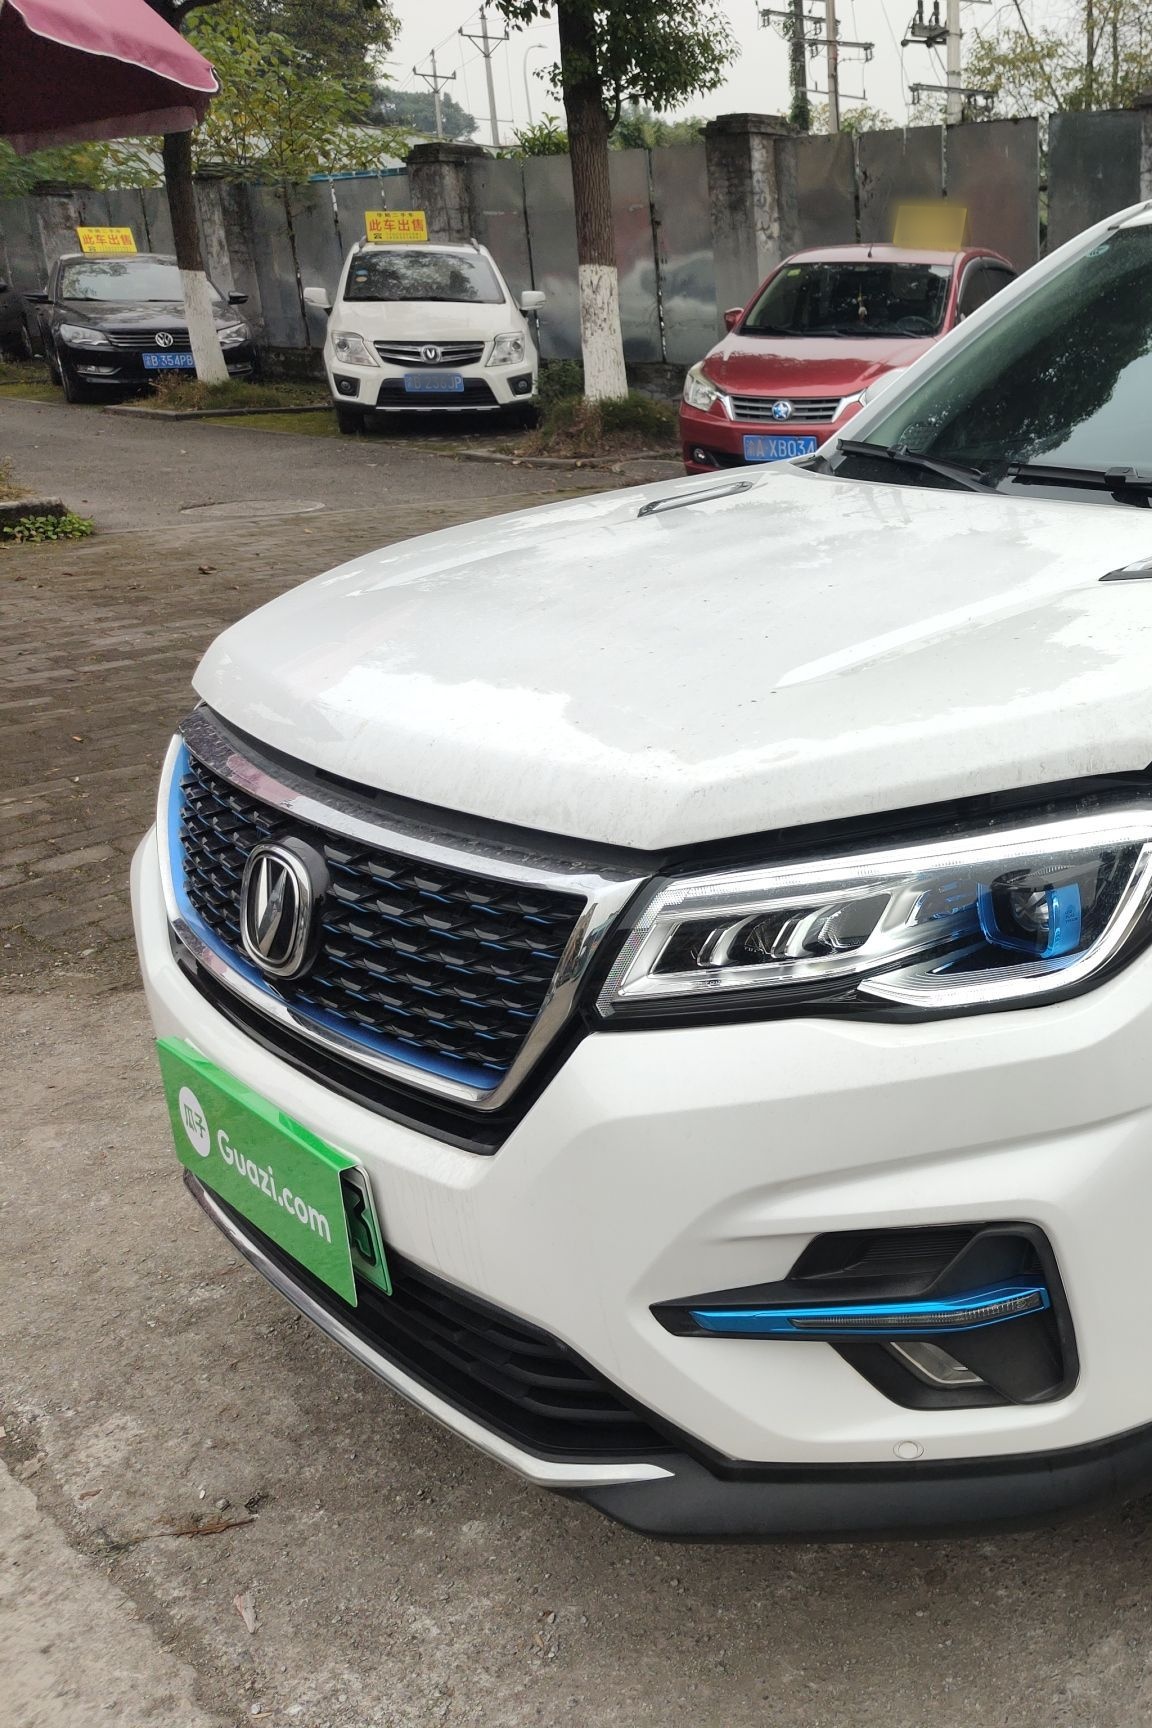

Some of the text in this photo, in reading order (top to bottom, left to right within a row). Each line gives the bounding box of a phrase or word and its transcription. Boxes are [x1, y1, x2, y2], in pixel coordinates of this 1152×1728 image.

[369, 218, 424, 232] 此车出售
[82, 233, 132, 246] 此车出售
[182, 1102, 206, 1139] 瓜子
[216, 1129, 332, 1245] Guazi.com
